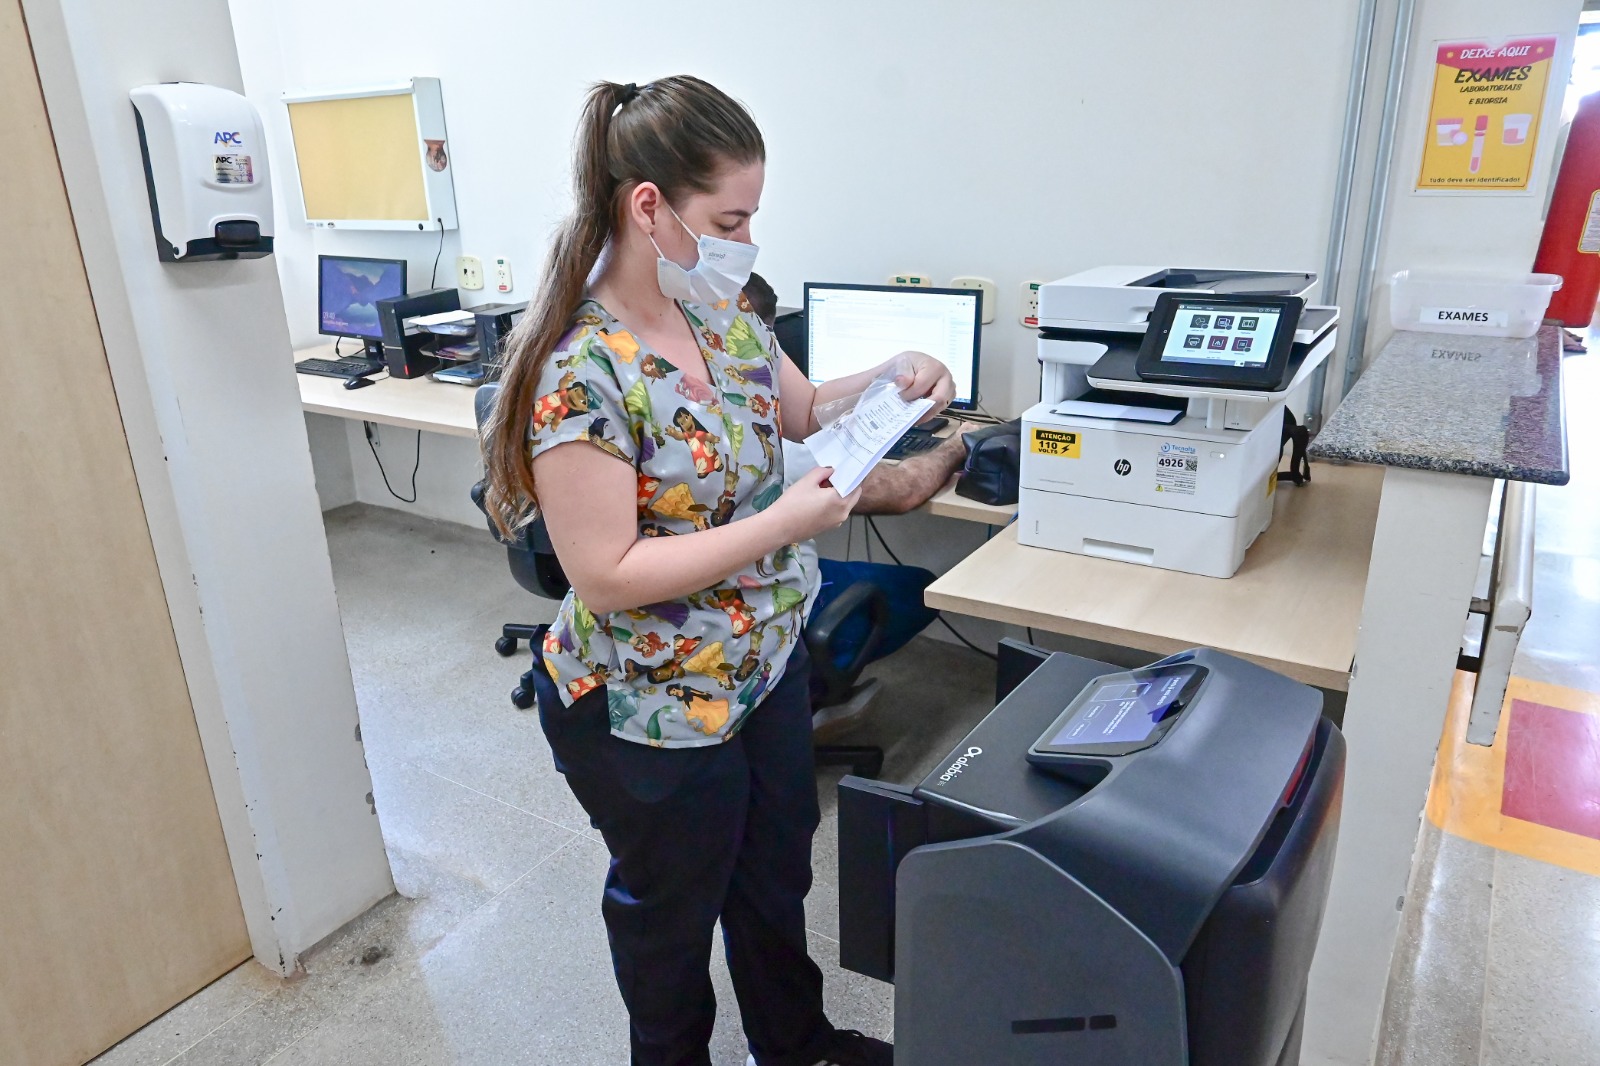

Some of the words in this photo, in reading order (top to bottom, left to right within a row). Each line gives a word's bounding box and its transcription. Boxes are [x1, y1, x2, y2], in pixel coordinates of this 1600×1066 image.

[1460, 48, 1496, 59] DEIXE
[1498, 45, 1531, 58] AQUI
[1454, 65, 1532, 83] EXAMES
[1460, 84, 1522, 92] LABORATORIAIS
[214, 132, 242, 144] APC
[215, 156, 232, 164] APC
[1438, 310, 1489, 322] EXAMES
[1040, 432, 1072, 441] ATENÇÃO
[1039, 440, 1058, 450] 110
[1114, 459, 1131, 476] hp
[1158, 458, 1184, 468] 4926
[939, 756, 969, 782] alabia
